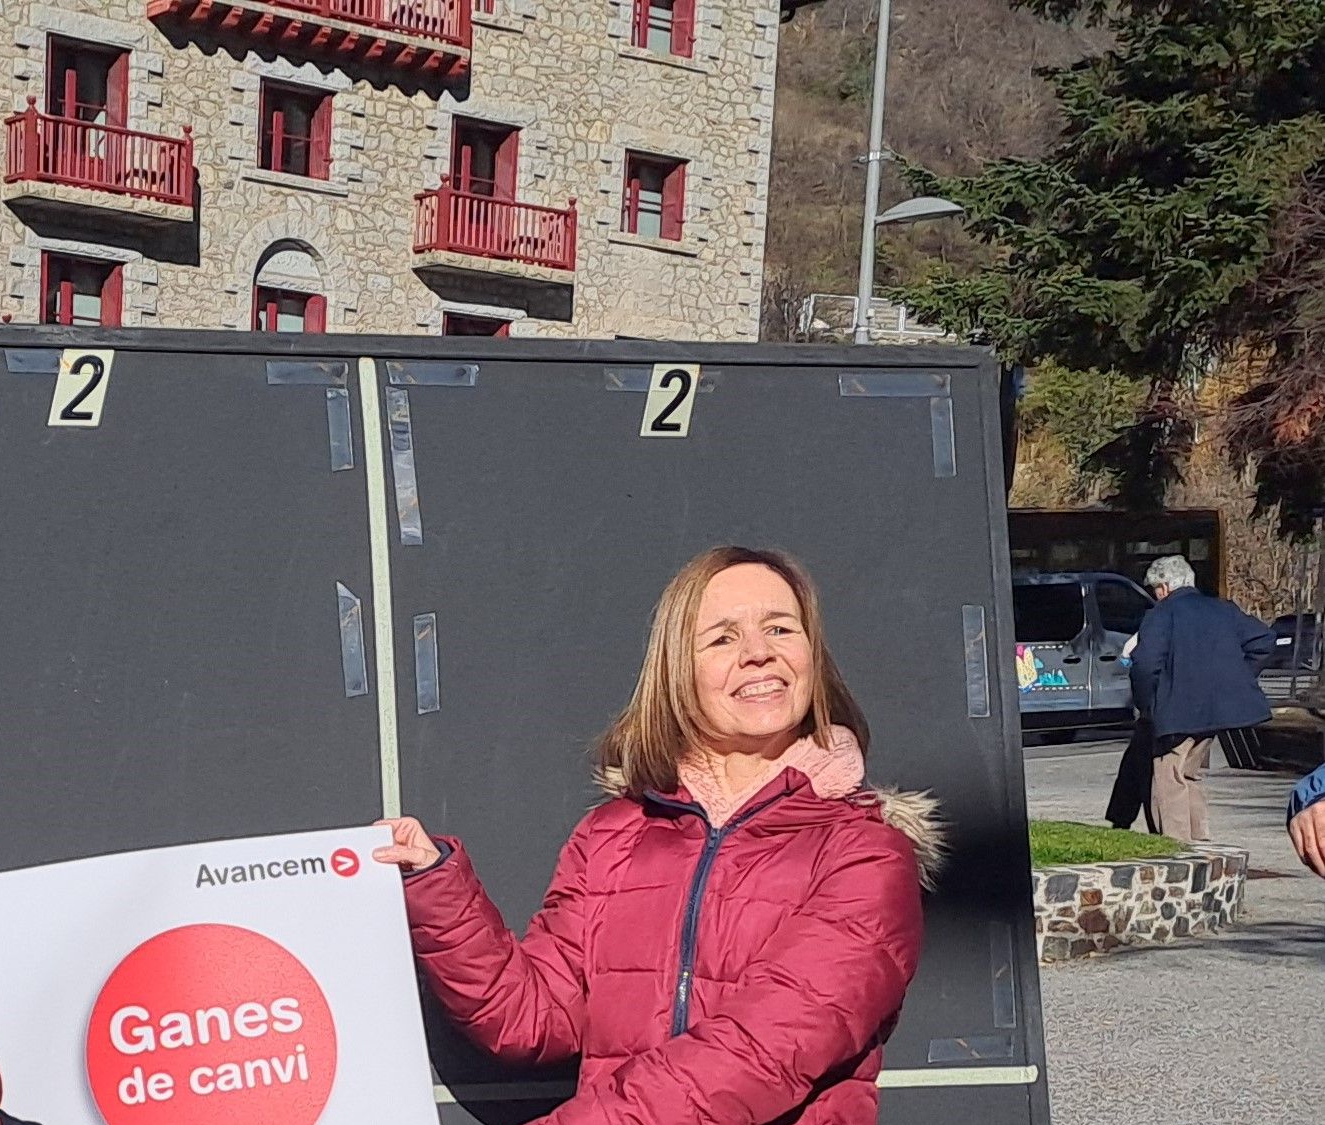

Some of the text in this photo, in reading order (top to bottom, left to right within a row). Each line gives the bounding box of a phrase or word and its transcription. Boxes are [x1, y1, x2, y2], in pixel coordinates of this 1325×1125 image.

[60, 355, 104, 420] 2
[651, 369, 692, 431] 2
[195, 855, 326, 888] Avancem
[109, 996, 303, 1055] Ganes
[118, 1043, 309, 1105] de canvi
